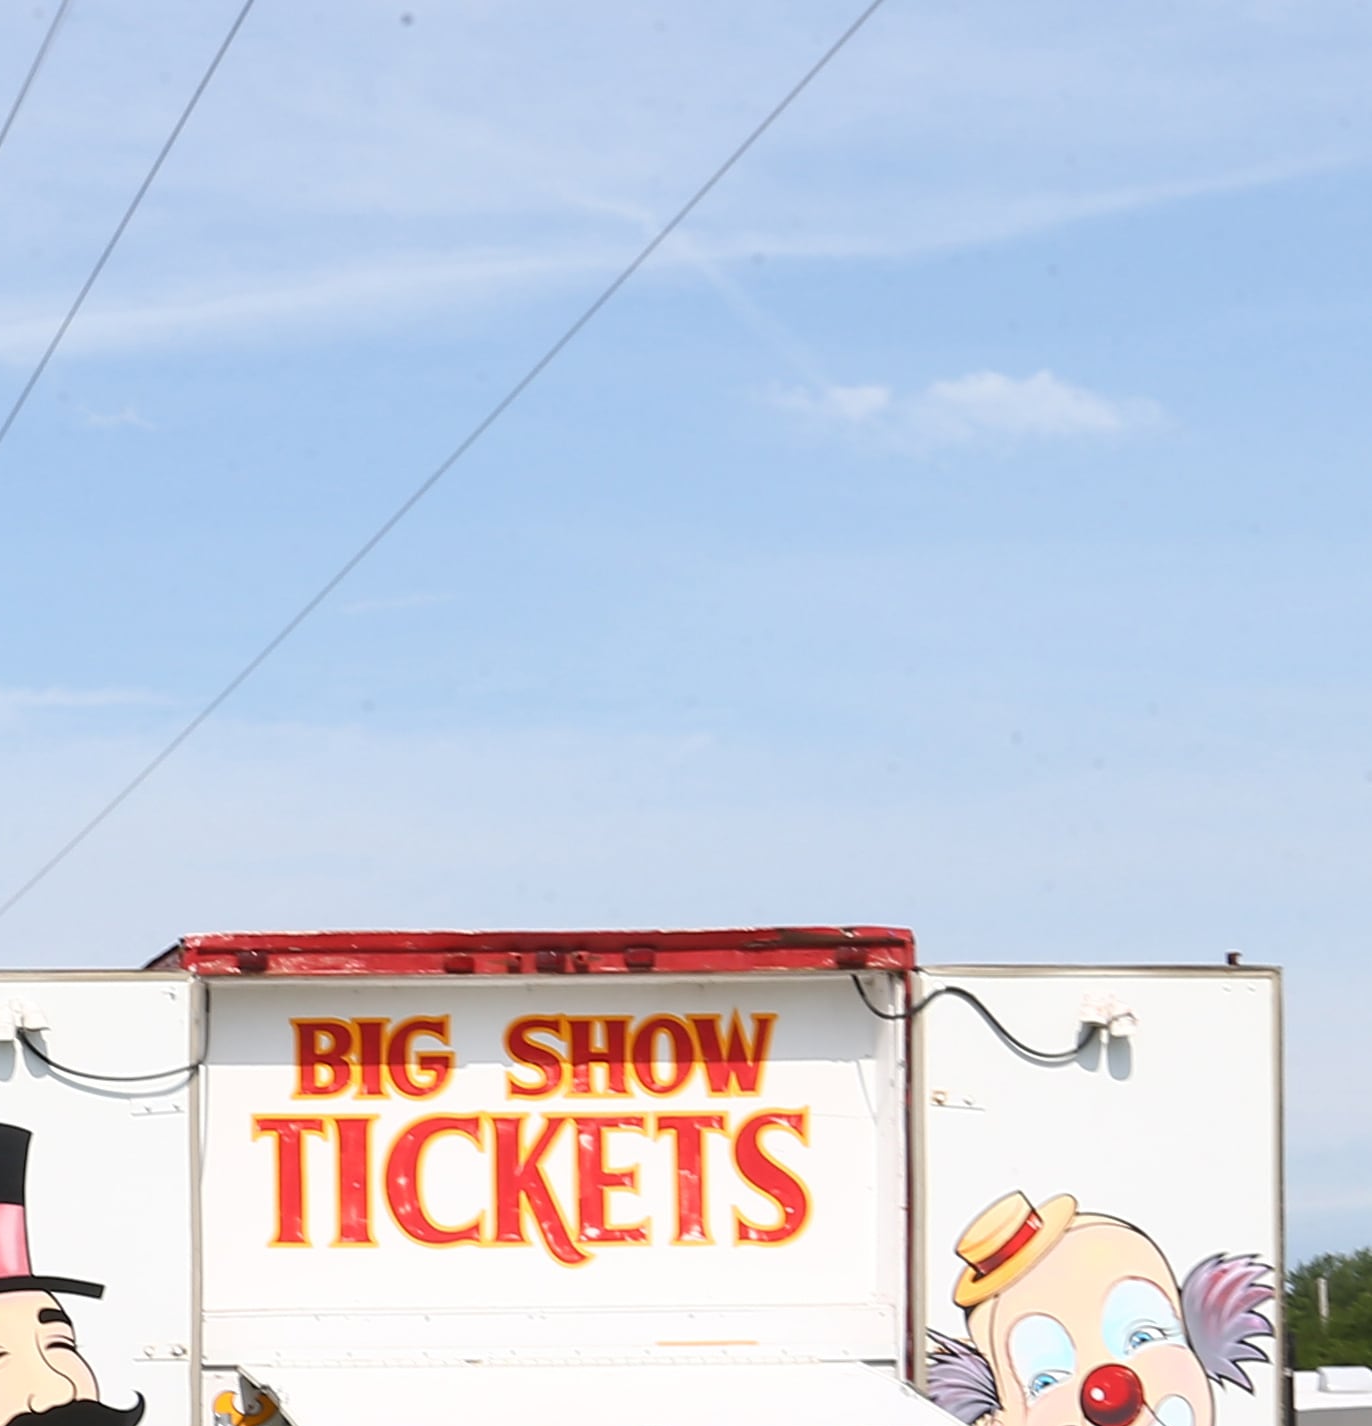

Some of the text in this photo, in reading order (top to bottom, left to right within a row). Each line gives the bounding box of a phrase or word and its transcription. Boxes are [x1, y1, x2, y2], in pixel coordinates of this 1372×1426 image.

[289, 1008, 779, 1100] BIG SHOW
[251, 1105, 812, 1269] TICKETS
